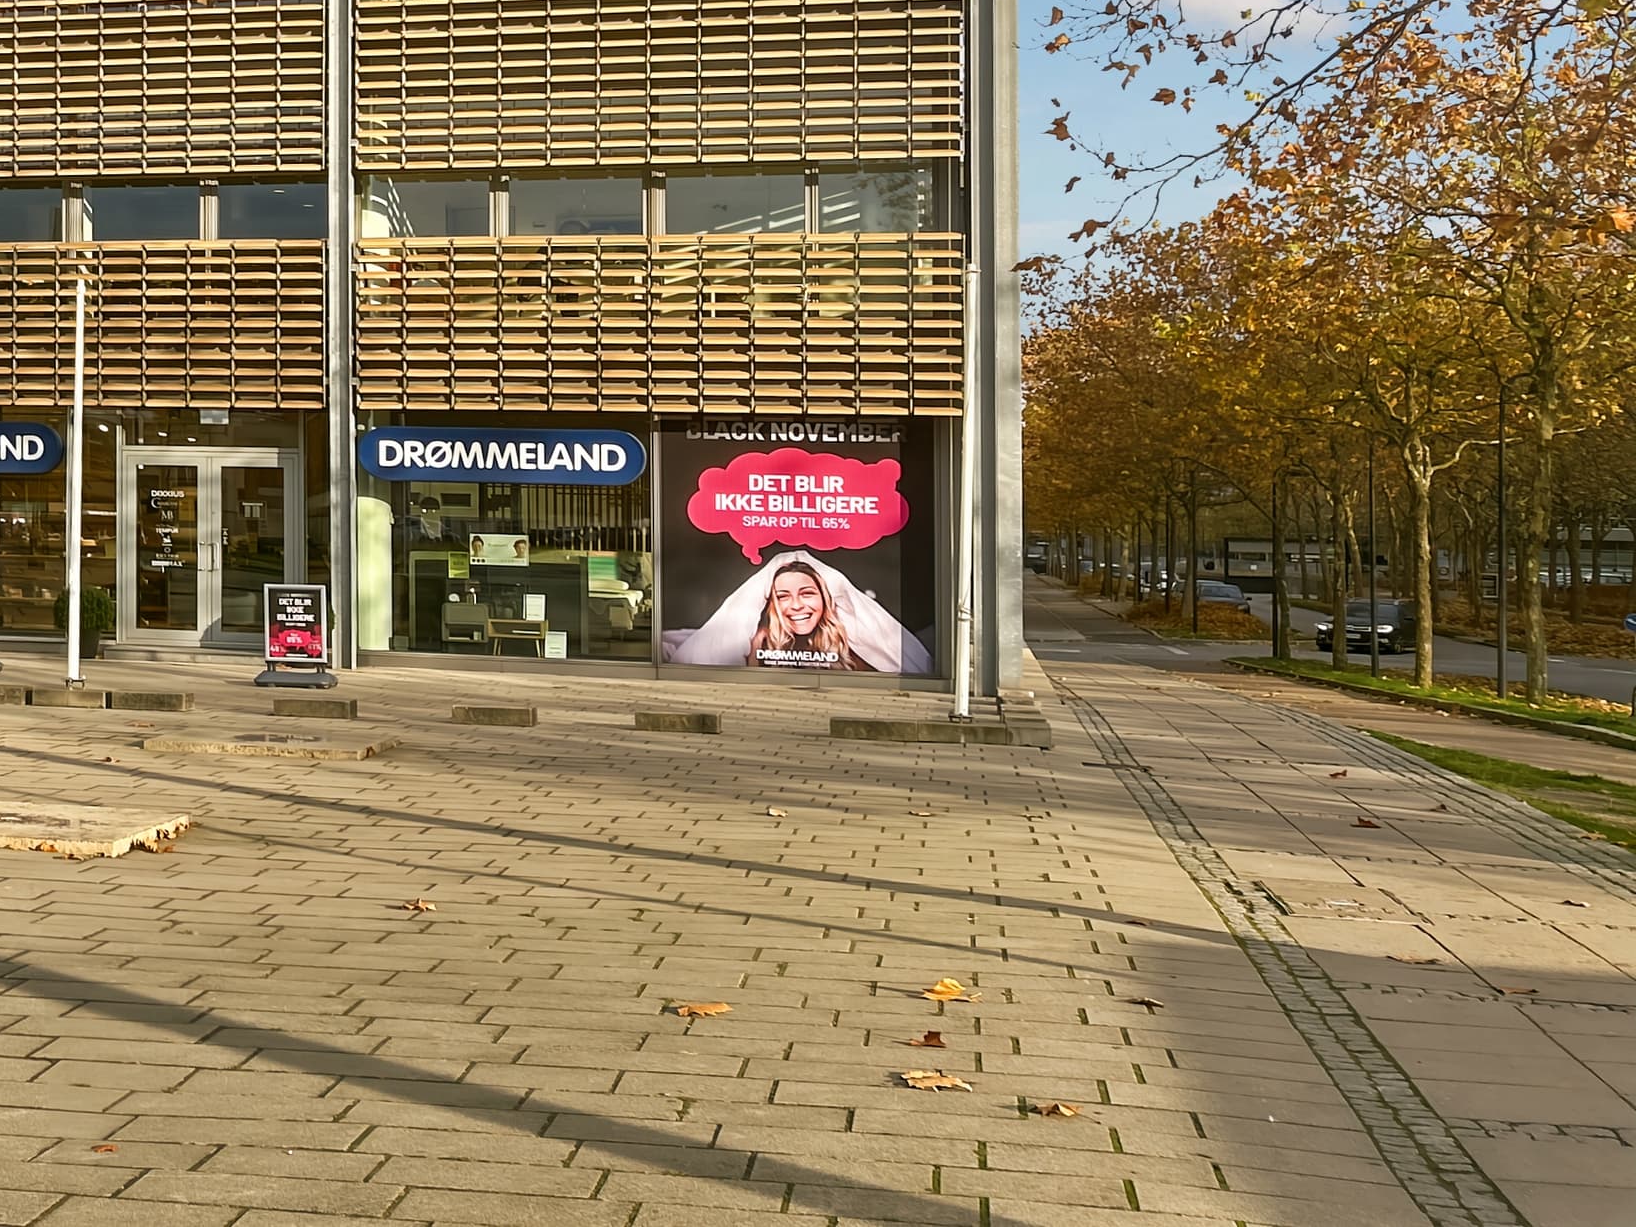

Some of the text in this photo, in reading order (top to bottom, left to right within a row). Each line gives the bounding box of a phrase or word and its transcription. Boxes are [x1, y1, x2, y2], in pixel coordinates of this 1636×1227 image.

[378, 440, 627, 472] DRØMMELAND
[748, 474, 844, 493] DET BLIR
[715, 493, 879, 515] IKKE BILLIGERE
[742, 515, 851, 530] SPAR OP TIL 65%
[756, 649, 839, 662] DRØMMELAND
